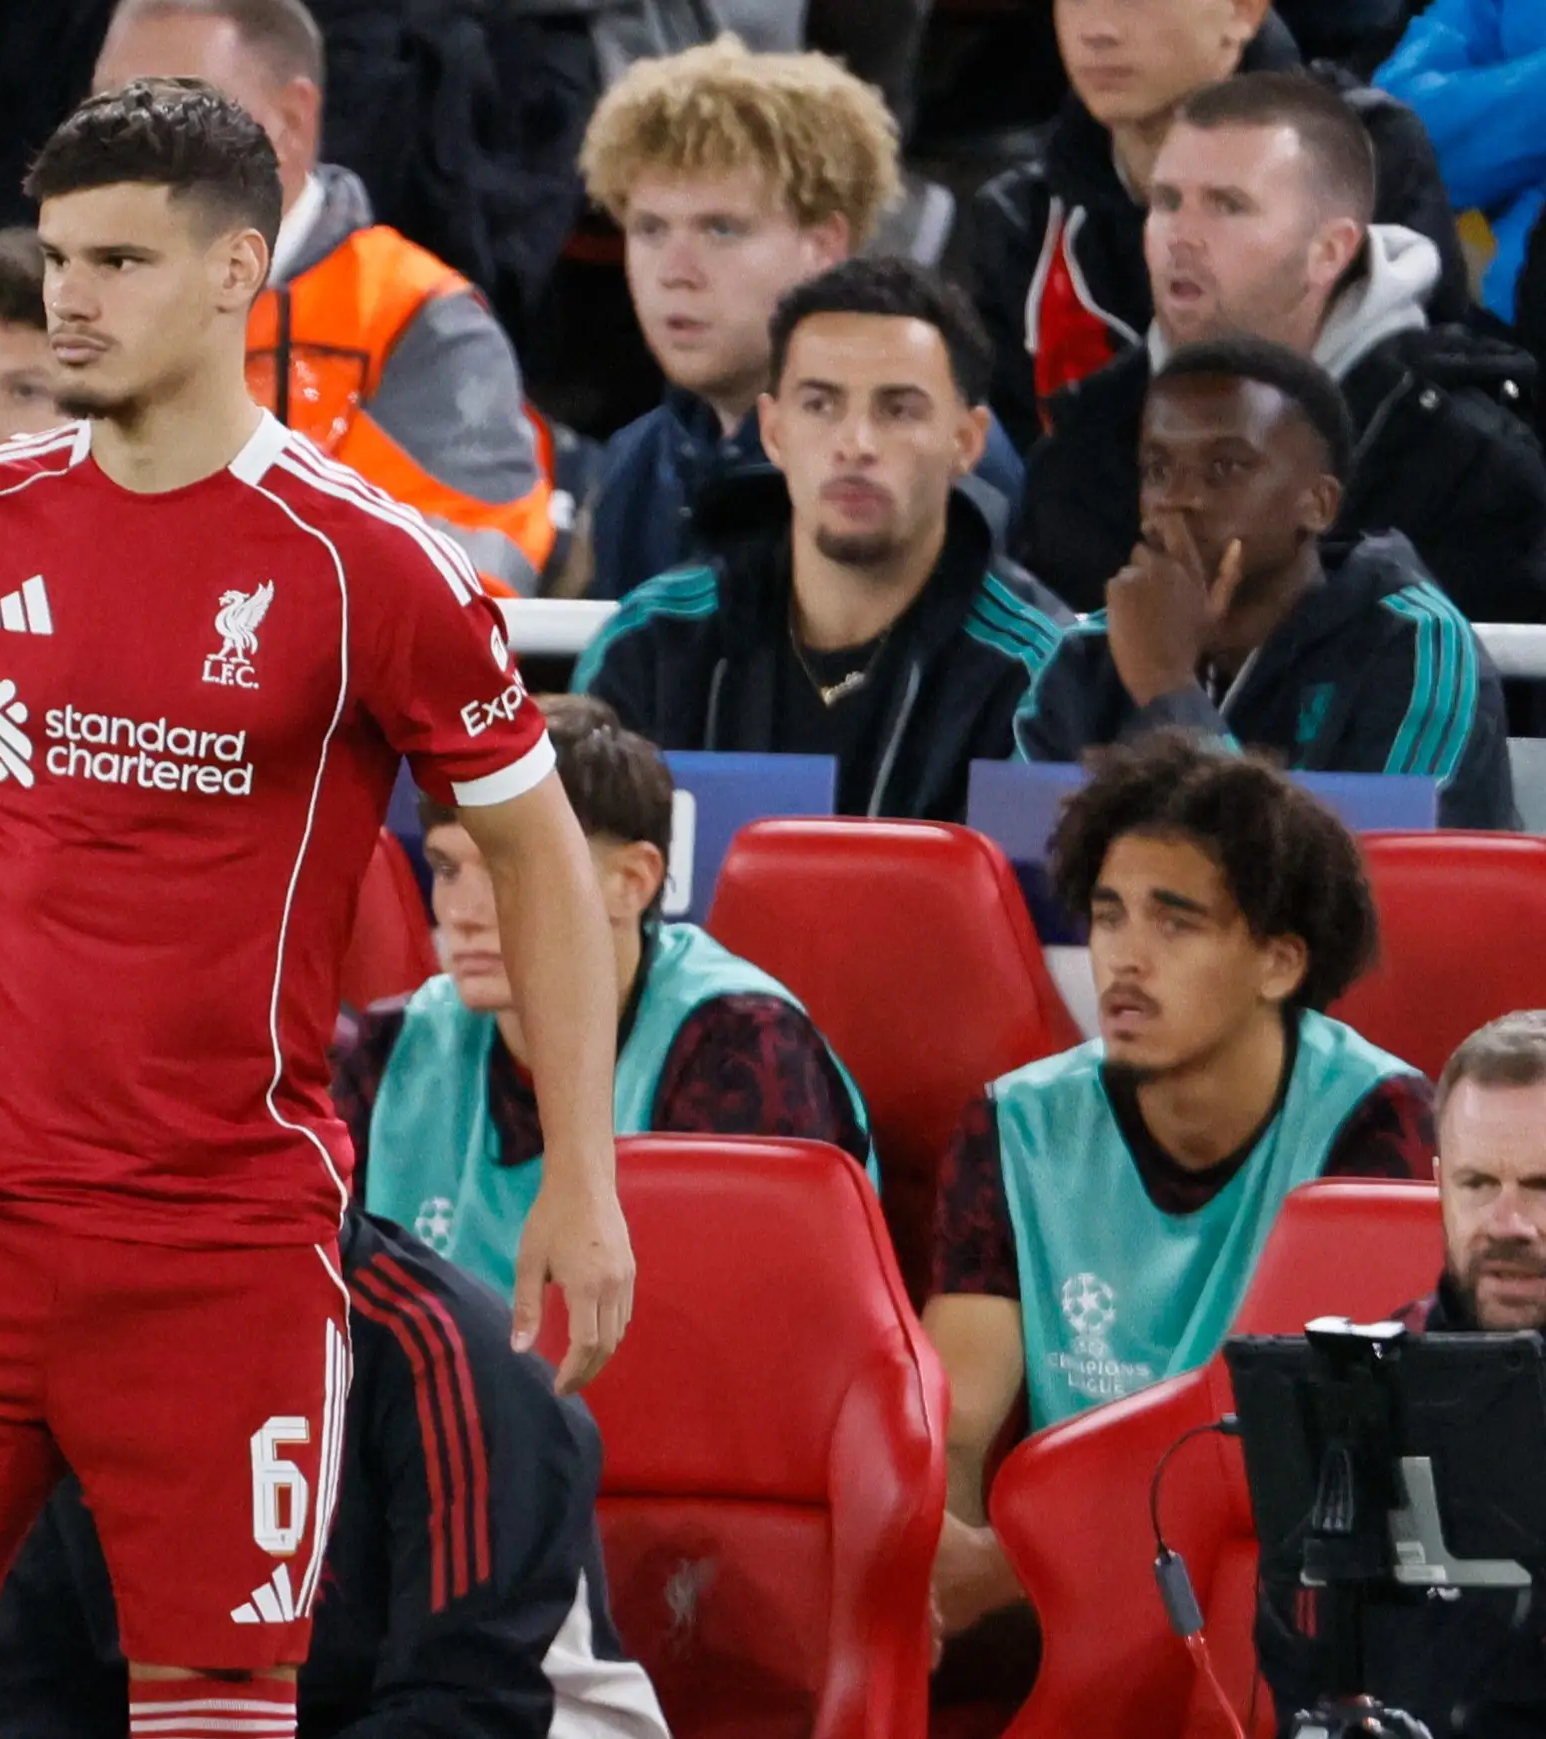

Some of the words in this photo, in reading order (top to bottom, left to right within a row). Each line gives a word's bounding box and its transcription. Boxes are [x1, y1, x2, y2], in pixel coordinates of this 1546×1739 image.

[45, 704, 246, 762] standard
[46, 741, 253, 795] chartered
[250, 1416, 309, 1557] 6
